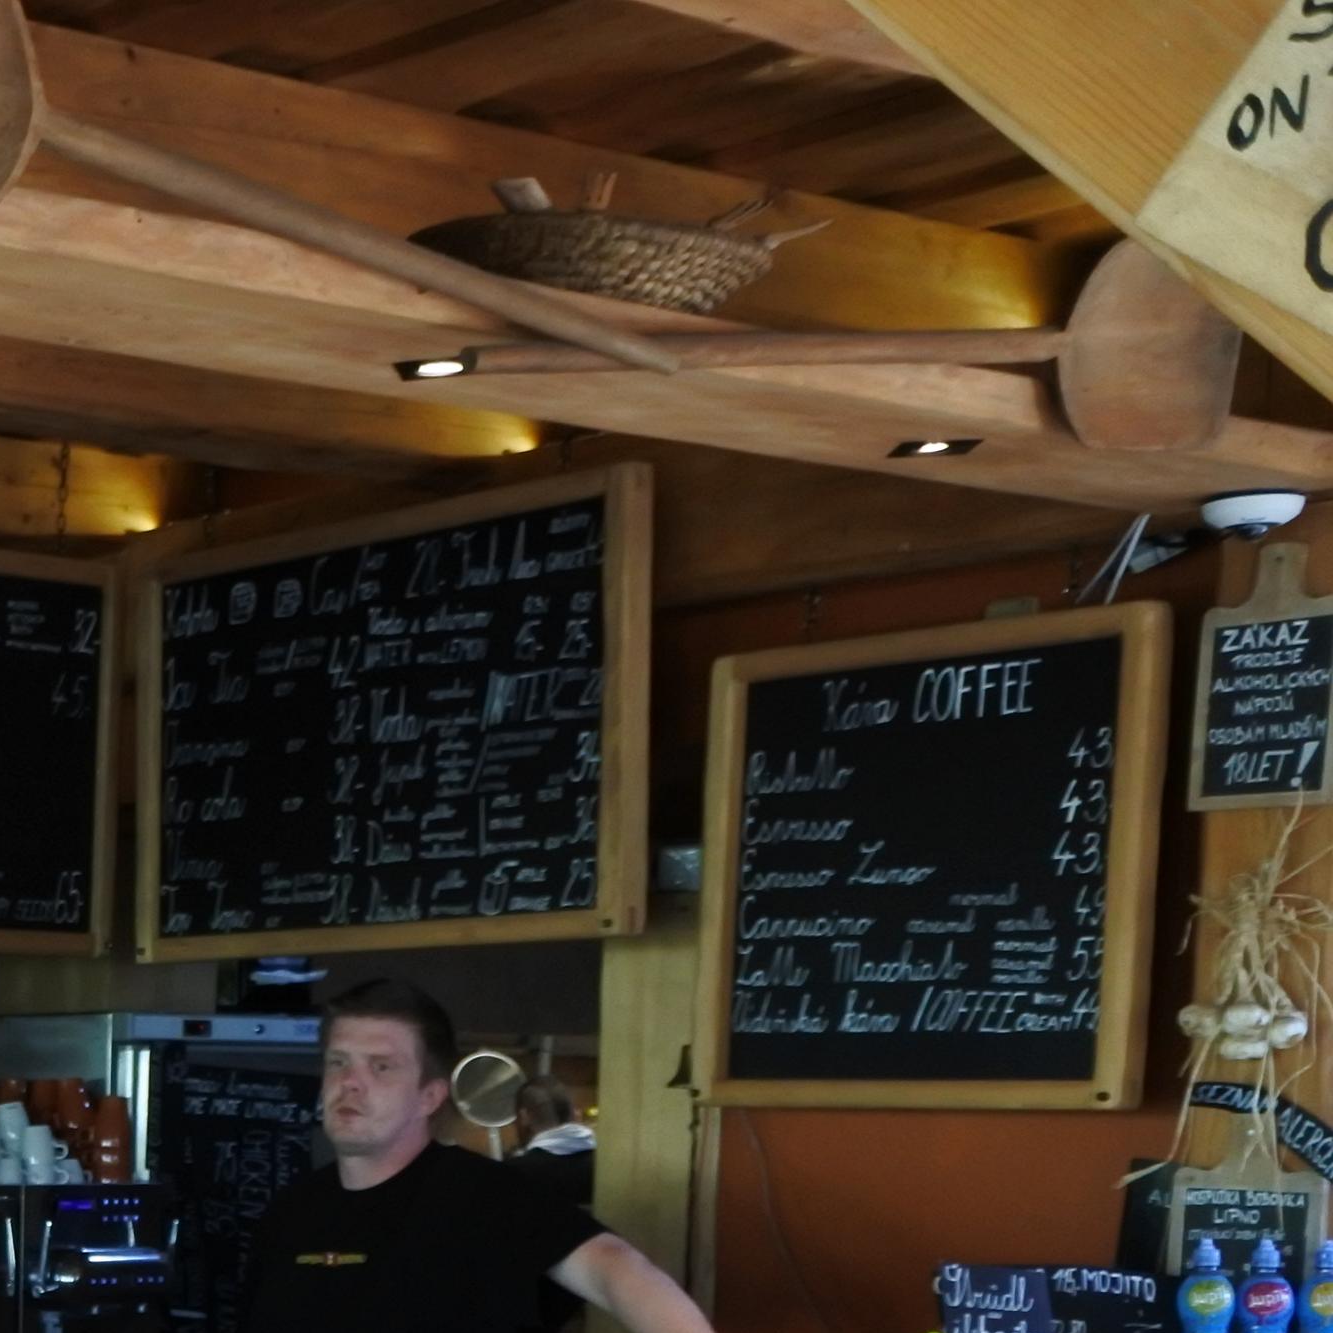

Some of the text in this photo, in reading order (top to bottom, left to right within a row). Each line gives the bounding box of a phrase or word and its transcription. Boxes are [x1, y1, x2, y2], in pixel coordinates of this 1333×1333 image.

[1221, 620, 1309, 653] ZÁKAZ
[1231, 648, 1305, 669] PRODEJE
[912, 658, 1043, 725] COFFEE
[1082, 1268, 1157, 1303] MOJITO
